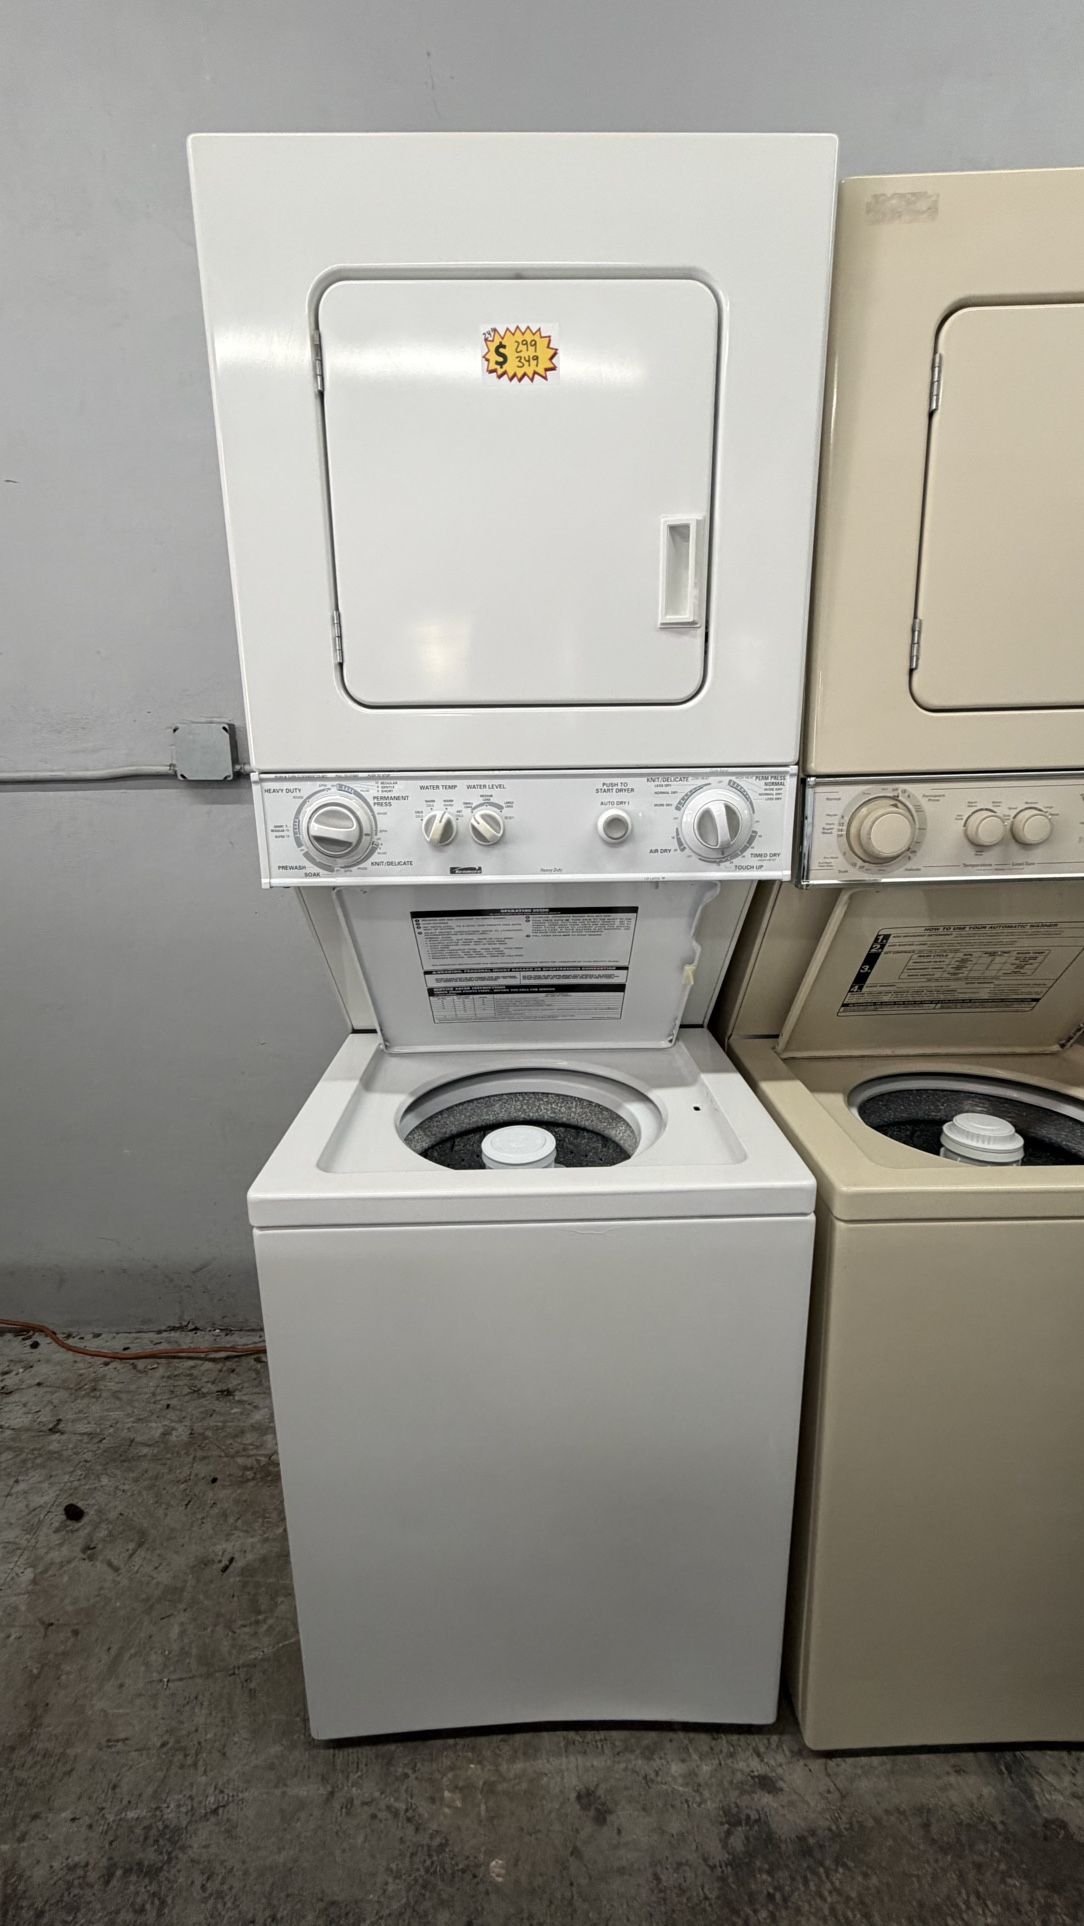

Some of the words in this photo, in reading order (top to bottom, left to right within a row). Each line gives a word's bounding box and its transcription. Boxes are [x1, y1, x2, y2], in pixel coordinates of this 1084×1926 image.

[494, 341, 508, 369] $
[515, 339, 538, 353] 299
[515, 355, 539, 368] 349
[876, 935, 886, 943] 1.
[869, 944, 882, 953] 2.
[860, 965, 871, 973] 3.
